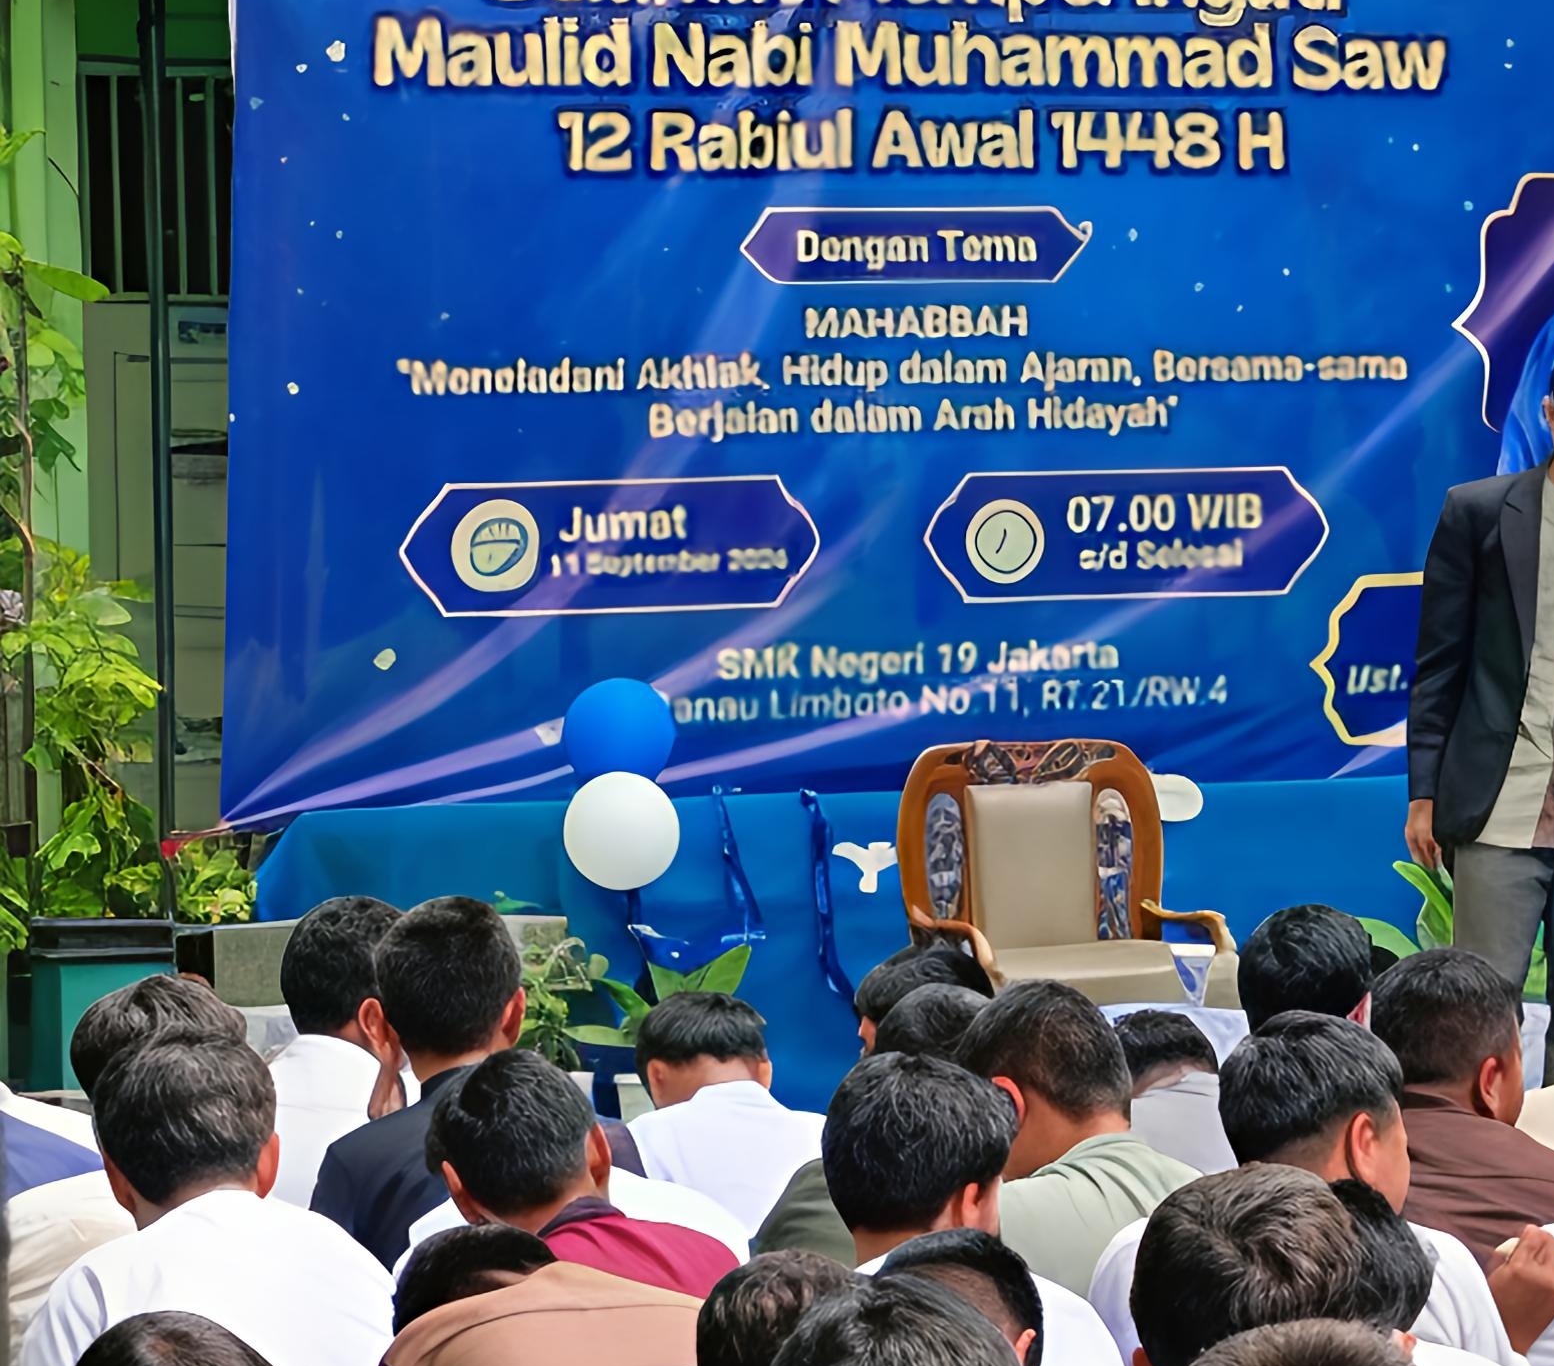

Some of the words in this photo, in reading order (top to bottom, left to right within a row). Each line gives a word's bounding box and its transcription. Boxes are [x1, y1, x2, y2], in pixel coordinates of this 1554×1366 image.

[373, 15, 634, 87] Maulid
[652, 20, 814, 88] Nabi
[834, 20, 1276, 90] Muhammad
[1292, 24, 1447, 91] Saw
[557, 111, 634, 172] 12
[649, 108, 853, 172] Rabiul
[871, 108, 1034, 170] Awal
[1049, 110, 1222, 170] 1448
[1237, 110, 1286, 171] H
[804, 304, 1029, 339] MAHABBAH
[782, 351, 890, 393] Hidup
[898, 348, 1008, 385] dalam
[809, 398, 923, 434] dalam
[932, 396, 1015, 432] Arah
[558, 504, 688, 544] Jumat
[1066, 493, 1176, 534] 07.00
[1186, 492, 1264, 532] WIB
[715, 641, 801, 681] SMK
[810, 640, 926, 685] Negeri
[937, 640, 978, 675] 19
[986, 638, 1120, 675] Jakarta
[671, 695, 760, 725] anau
